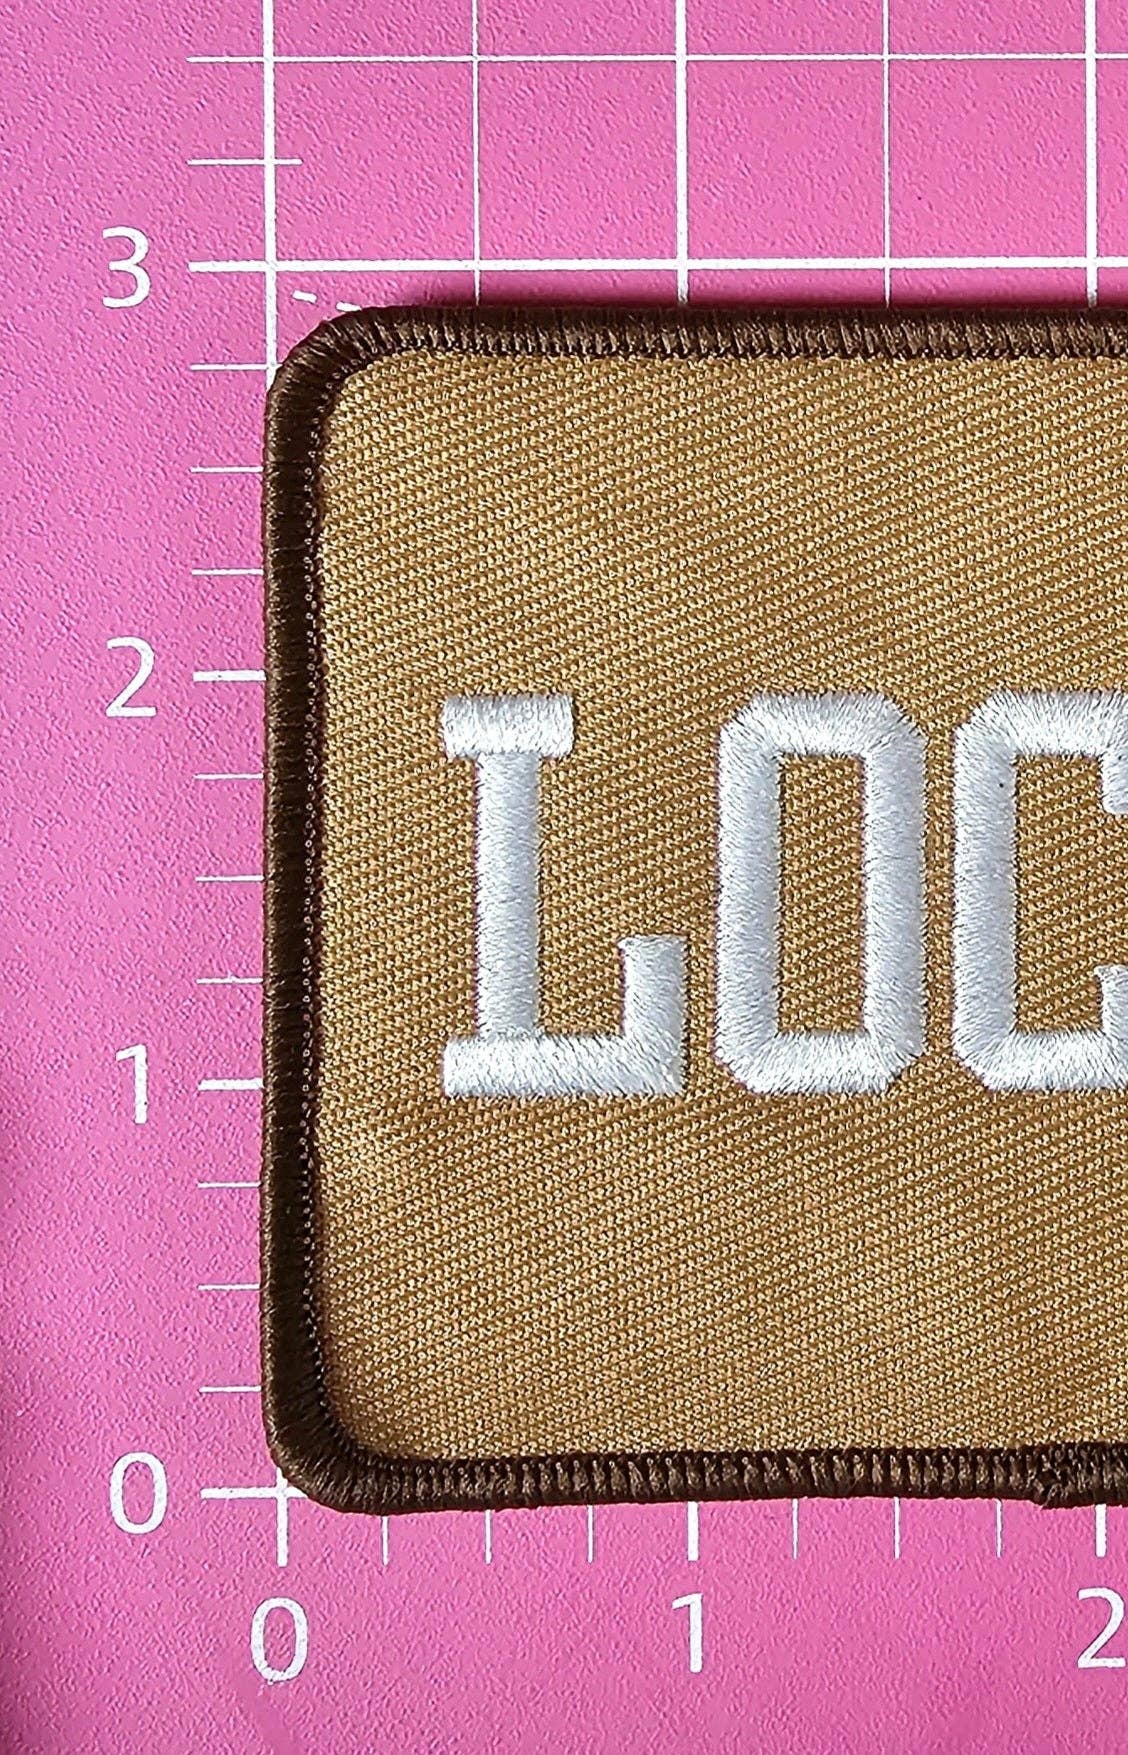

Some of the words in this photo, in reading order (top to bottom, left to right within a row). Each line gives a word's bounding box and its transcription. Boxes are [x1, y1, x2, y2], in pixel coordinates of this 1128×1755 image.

[102, 226, 152, 308] 3
[106, 637, 156, 717] 2
[115, 1043, 149, 1125] 1
[110, 1452, 169, 1535] 0
[251, 1597, 310, 1684] 0
[671, 1592, 704, 1674] 1
[1077, 1587, 1126, 1669] 2
